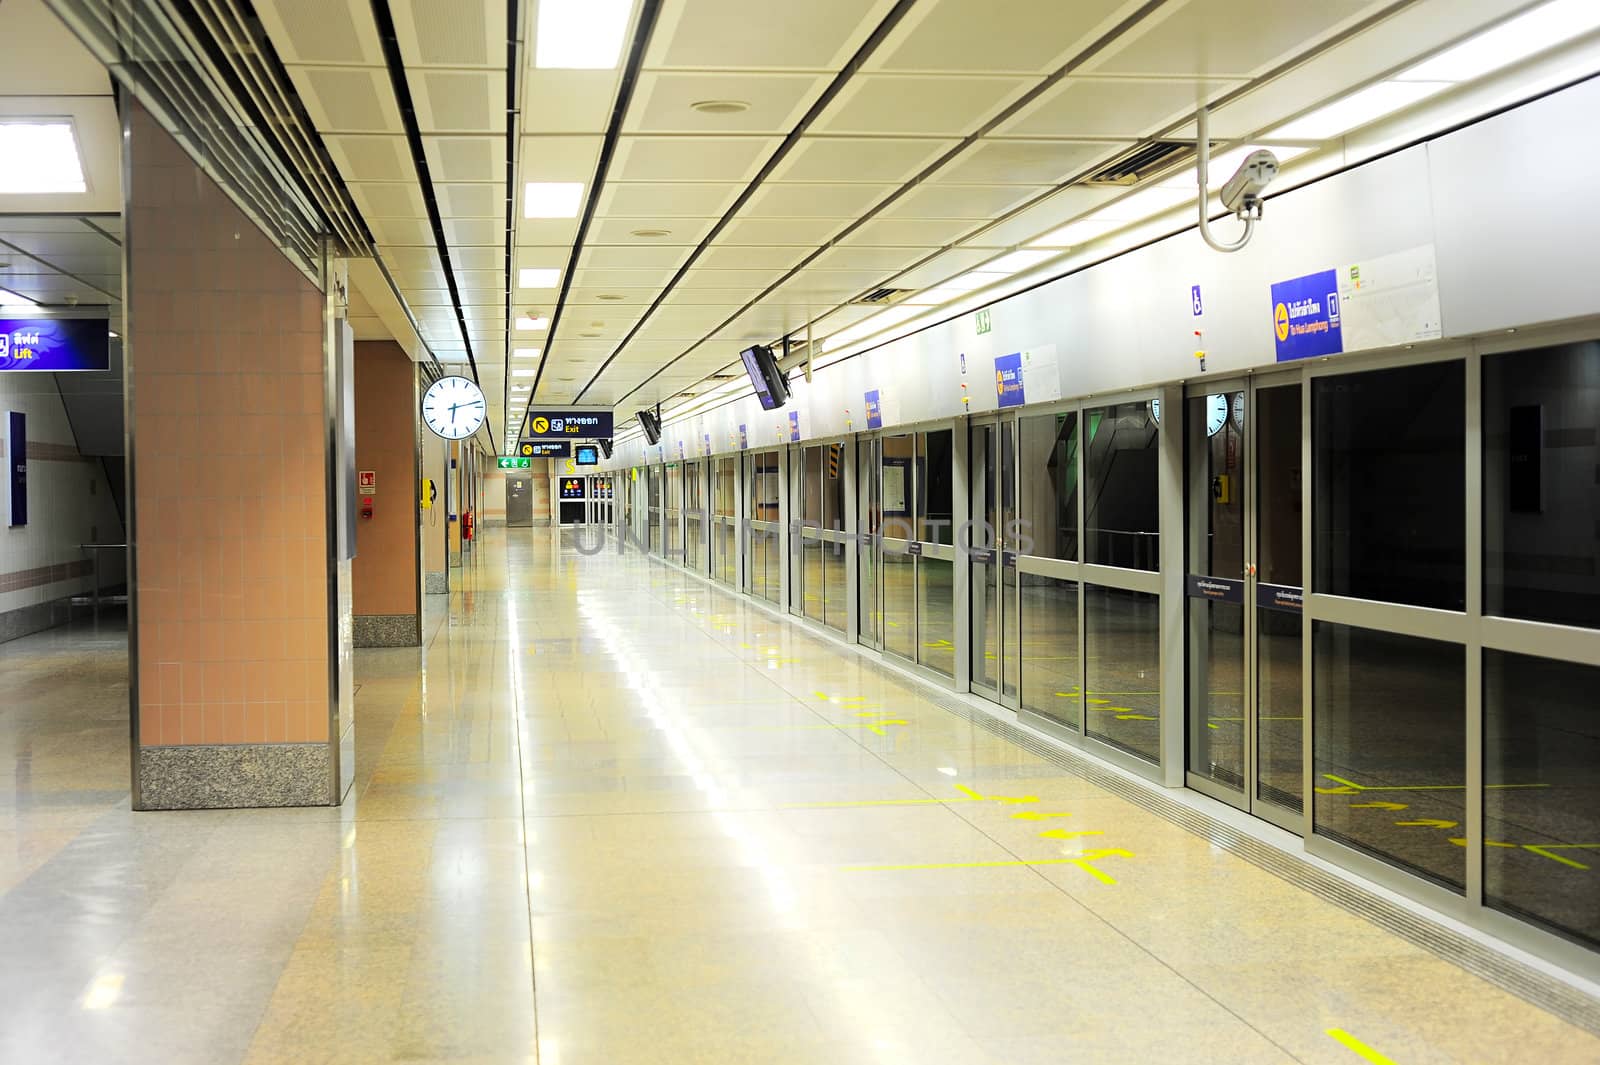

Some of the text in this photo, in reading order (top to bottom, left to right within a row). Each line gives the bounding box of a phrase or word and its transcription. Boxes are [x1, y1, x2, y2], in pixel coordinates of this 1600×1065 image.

[14, 348, 33, 359] Lift
[565, 417, 598, 425] ทางออก
[565, 425, 580, 433] Exit
